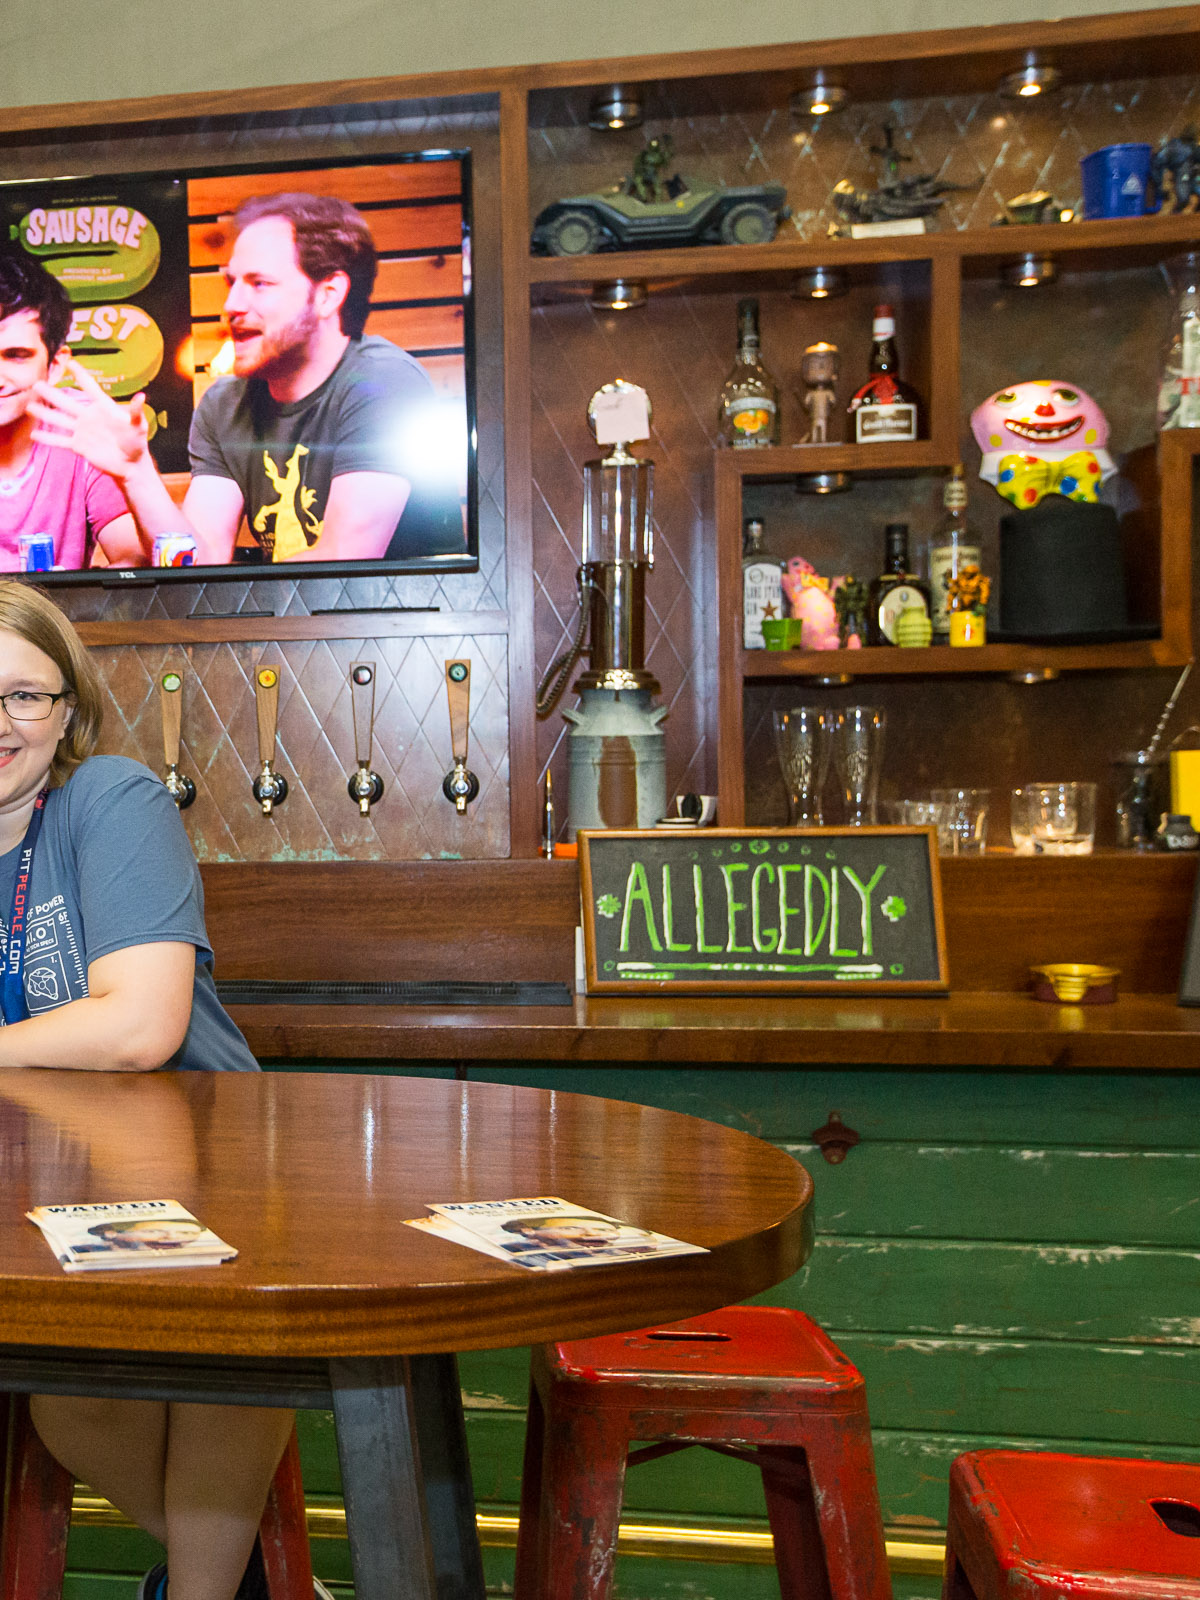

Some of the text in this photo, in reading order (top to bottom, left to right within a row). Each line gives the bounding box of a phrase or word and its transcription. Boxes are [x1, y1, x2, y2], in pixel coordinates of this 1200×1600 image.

[26, 207, 148, 250] SAUSAGE
[65, 306, 150, 343] EST
[119, 571, 137, 579] TCL
[35, 894, 65, 915] POWER
[618, 860, 887, 958] ALLEGEDLY
[48, 1202, 167, 1213] WANTED
[442, 1199, 560, 1211] WANTED
